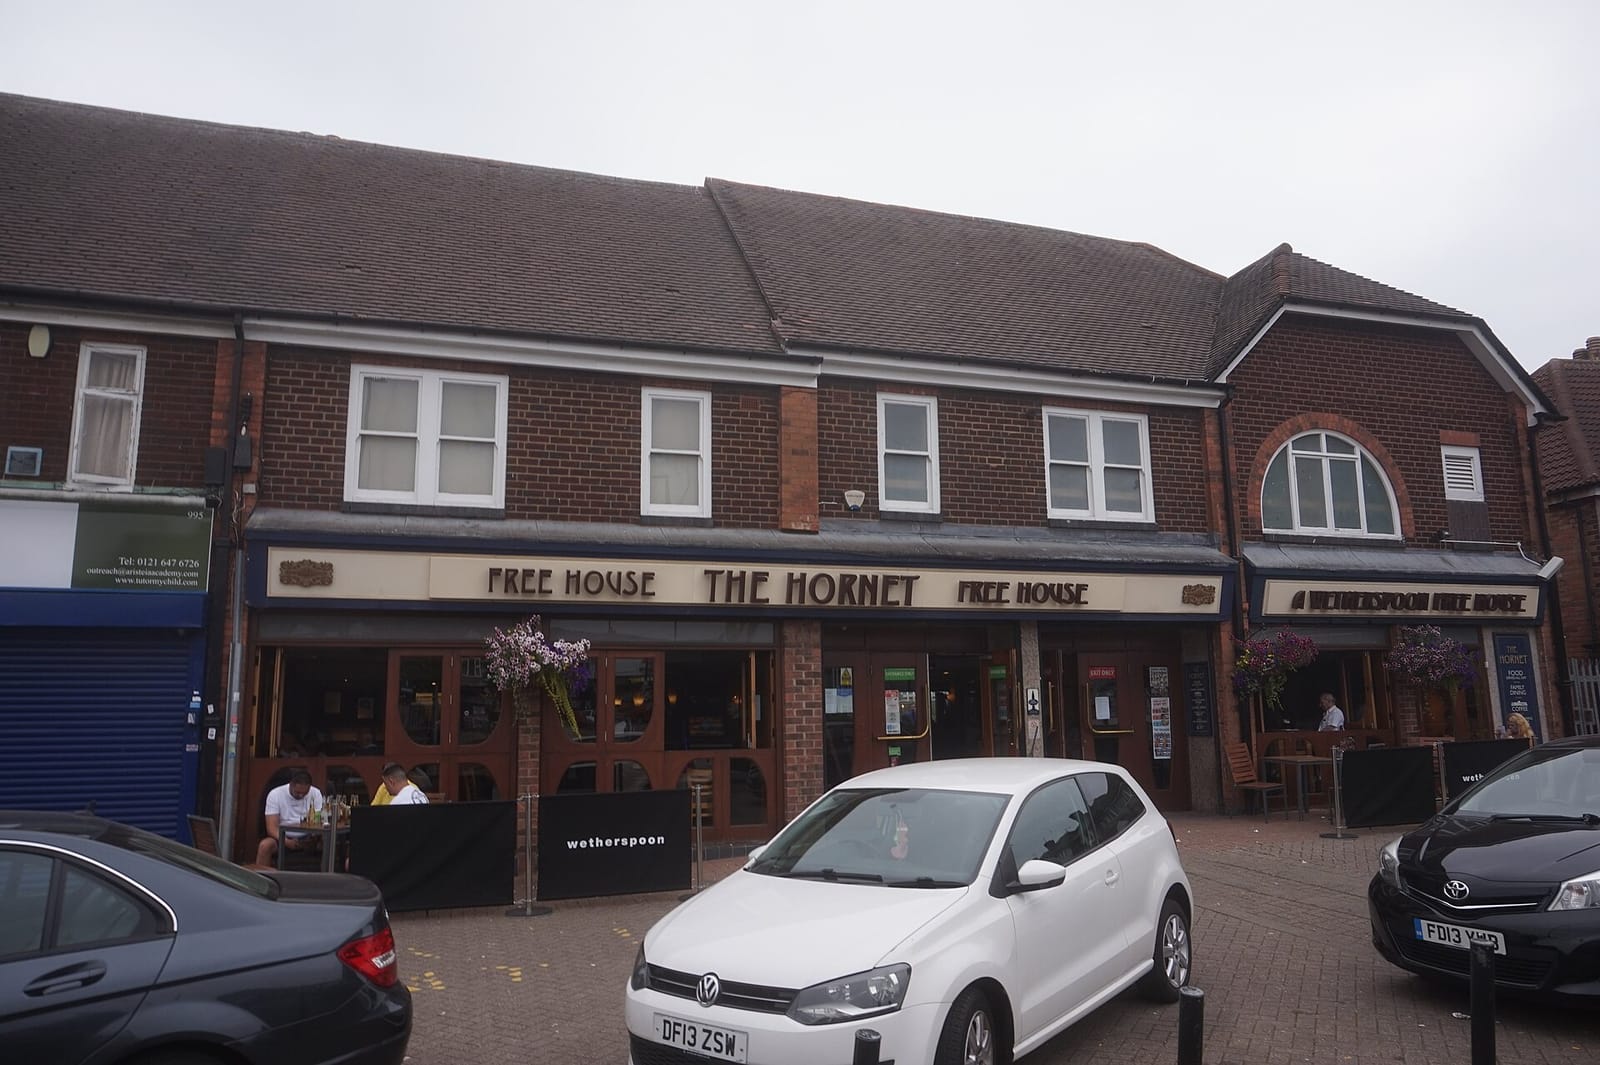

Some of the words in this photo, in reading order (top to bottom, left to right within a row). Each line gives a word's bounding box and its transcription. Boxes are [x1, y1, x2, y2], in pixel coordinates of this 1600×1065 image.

[187, 511, 204, 520] 995
[119, 556, 135, 566] Tel:
[137, 557, 157, 567] 0121
[160, 558, 177, 567] 647
[178, 559, 200, 568] 6726
[115, 577, 199, 587] www.tutormychild.com
[487, 567, 553, 595] FREE
[564, 569, 657, 597] HOUSE
[703, 568, 770, 604] THE
[785, 571, 921, 607] HORNET
[957, 580, 1010, 604] FREE
[1016, 582, 1089, 606] HOUSE
[1291, 591, 1304, 610] A
[1309, 591, 1430, 611] WETHERSPOON
[1473, 593, 1527, 613] HOUSE
[566, 836, 665, 849] wetherspoon
[1426, 923, 1461, 944] FD13
[662, 1019, 697, 1048] DF13
[702, 1028, 736, 1057] ZSW
